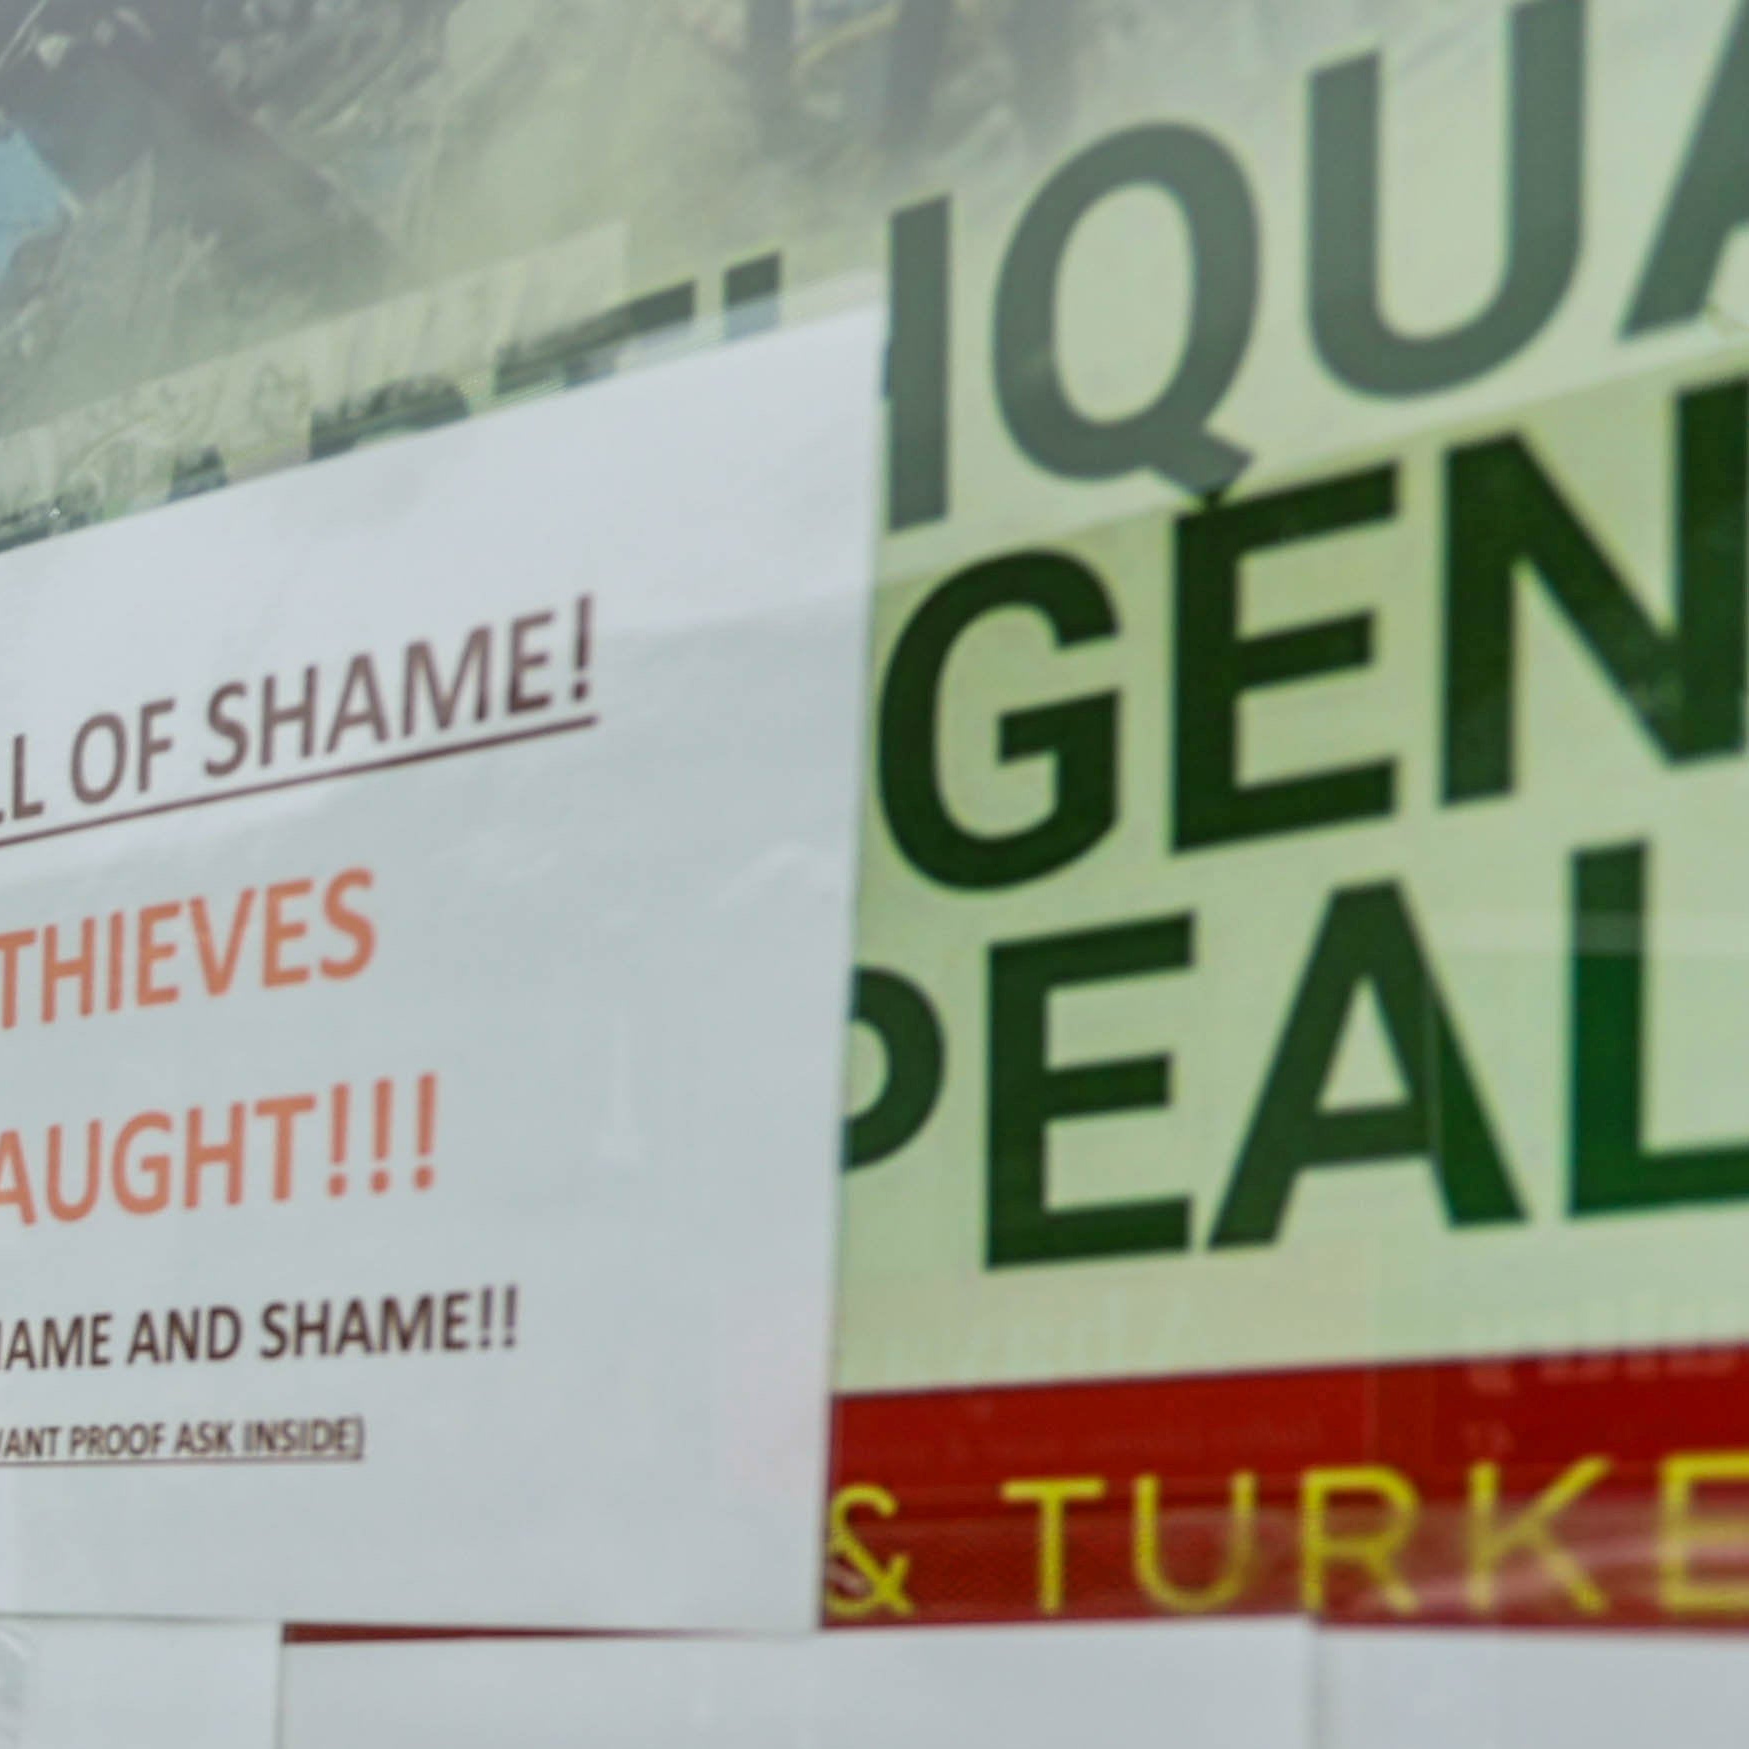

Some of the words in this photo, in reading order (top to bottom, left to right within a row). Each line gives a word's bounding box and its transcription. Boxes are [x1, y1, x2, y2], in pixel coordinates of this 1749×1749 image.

[70, 699, 176, 803] OF
[203, 594, 597, 777] SHAME!
[126, 1305, 242, 1365] AND
[258, 1285, 519, 1360] SHAME!!
[69, 1421, 165, 1458] PROOF
[173, 1419, 234, 1456] ASK
[242, 1415, 364, 1459] INSIDE)
[824, 1484, 914, 1616] &
